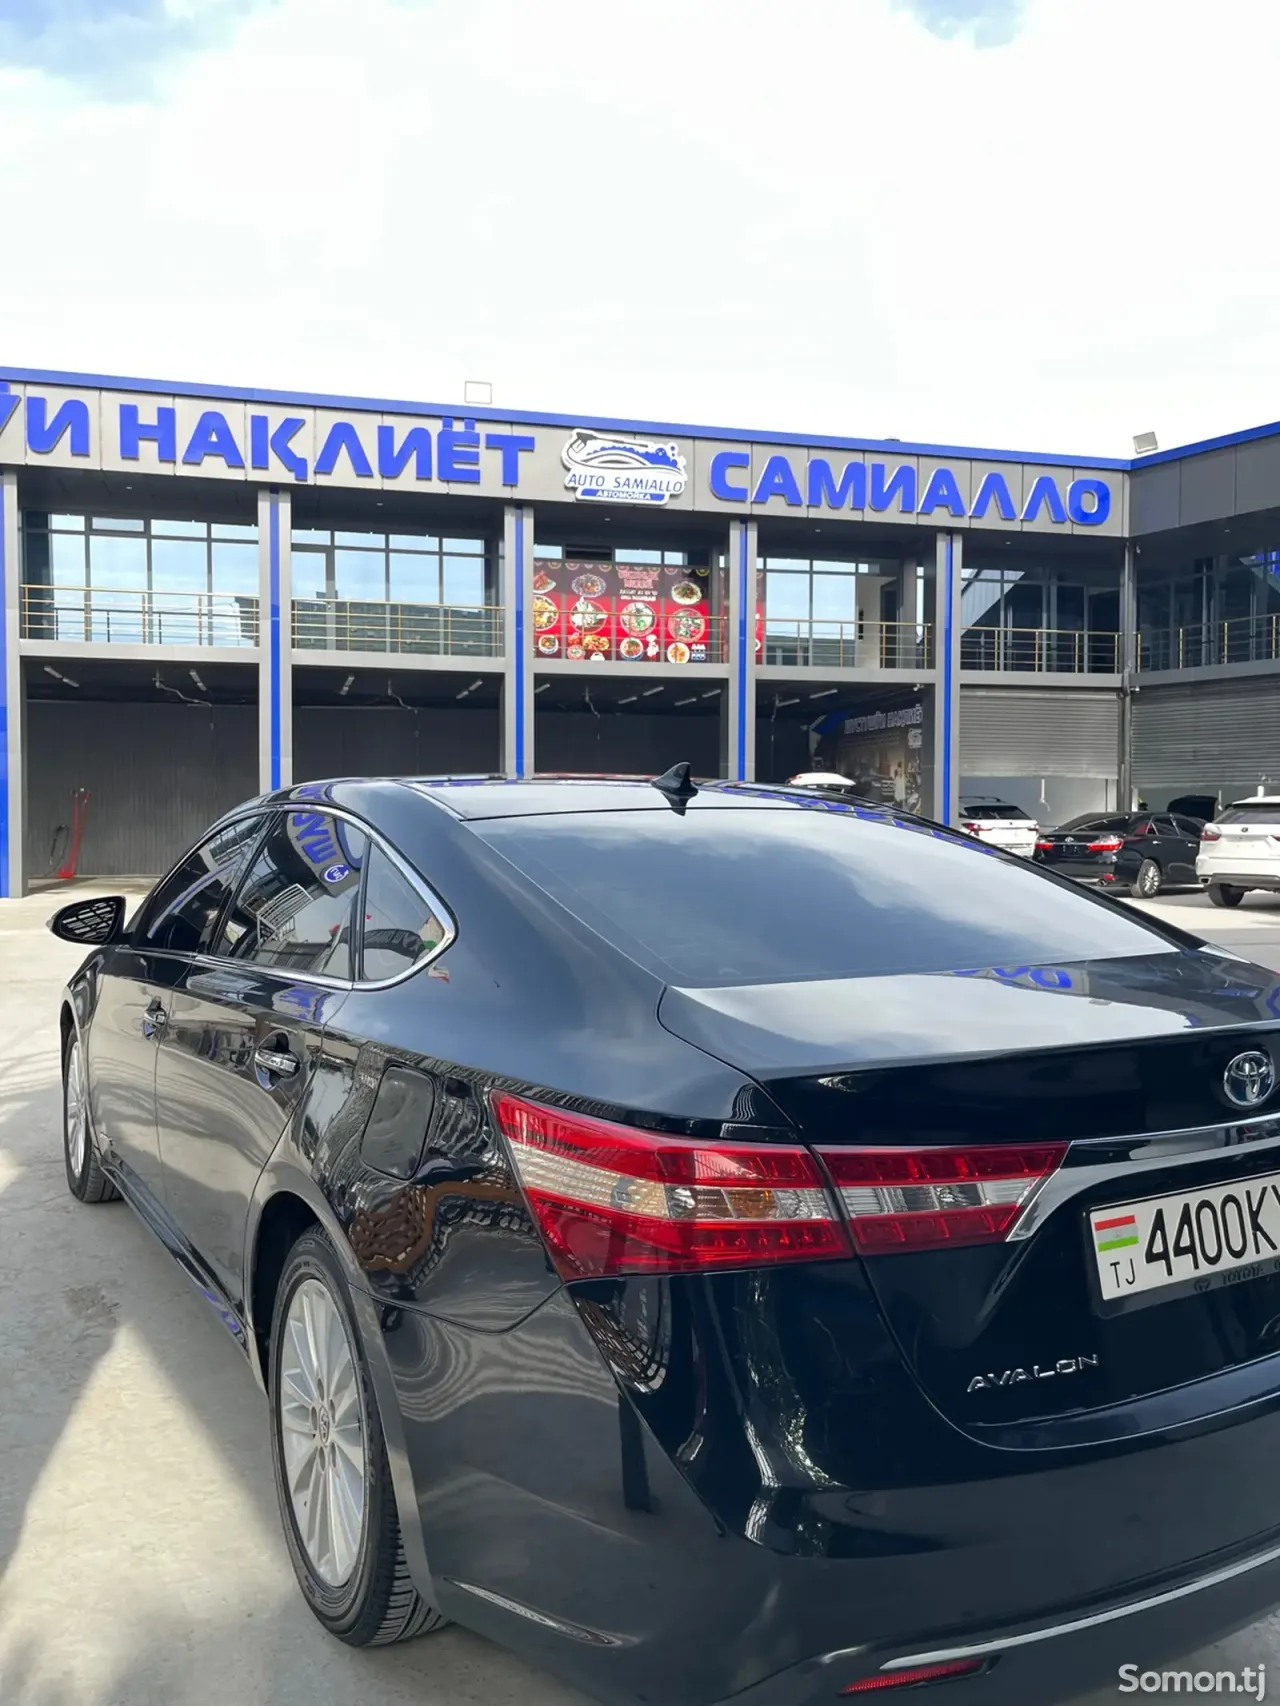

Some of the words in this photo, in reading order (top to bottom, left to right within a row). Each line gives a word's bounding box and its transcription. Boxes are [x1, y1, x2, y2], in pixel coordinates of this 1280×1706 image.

[118, 403, 535, 487] НАҚЛИЁТ
[567, 473, 606, 488] AUTO
[613, 476, 683, 493] SAMIALLO
[710, 450, 1112, 526] САМИАЛЛО
[1109, 1258, 1137, 1288] TJ
[967, 1353, 1100, 1393] AVALON
